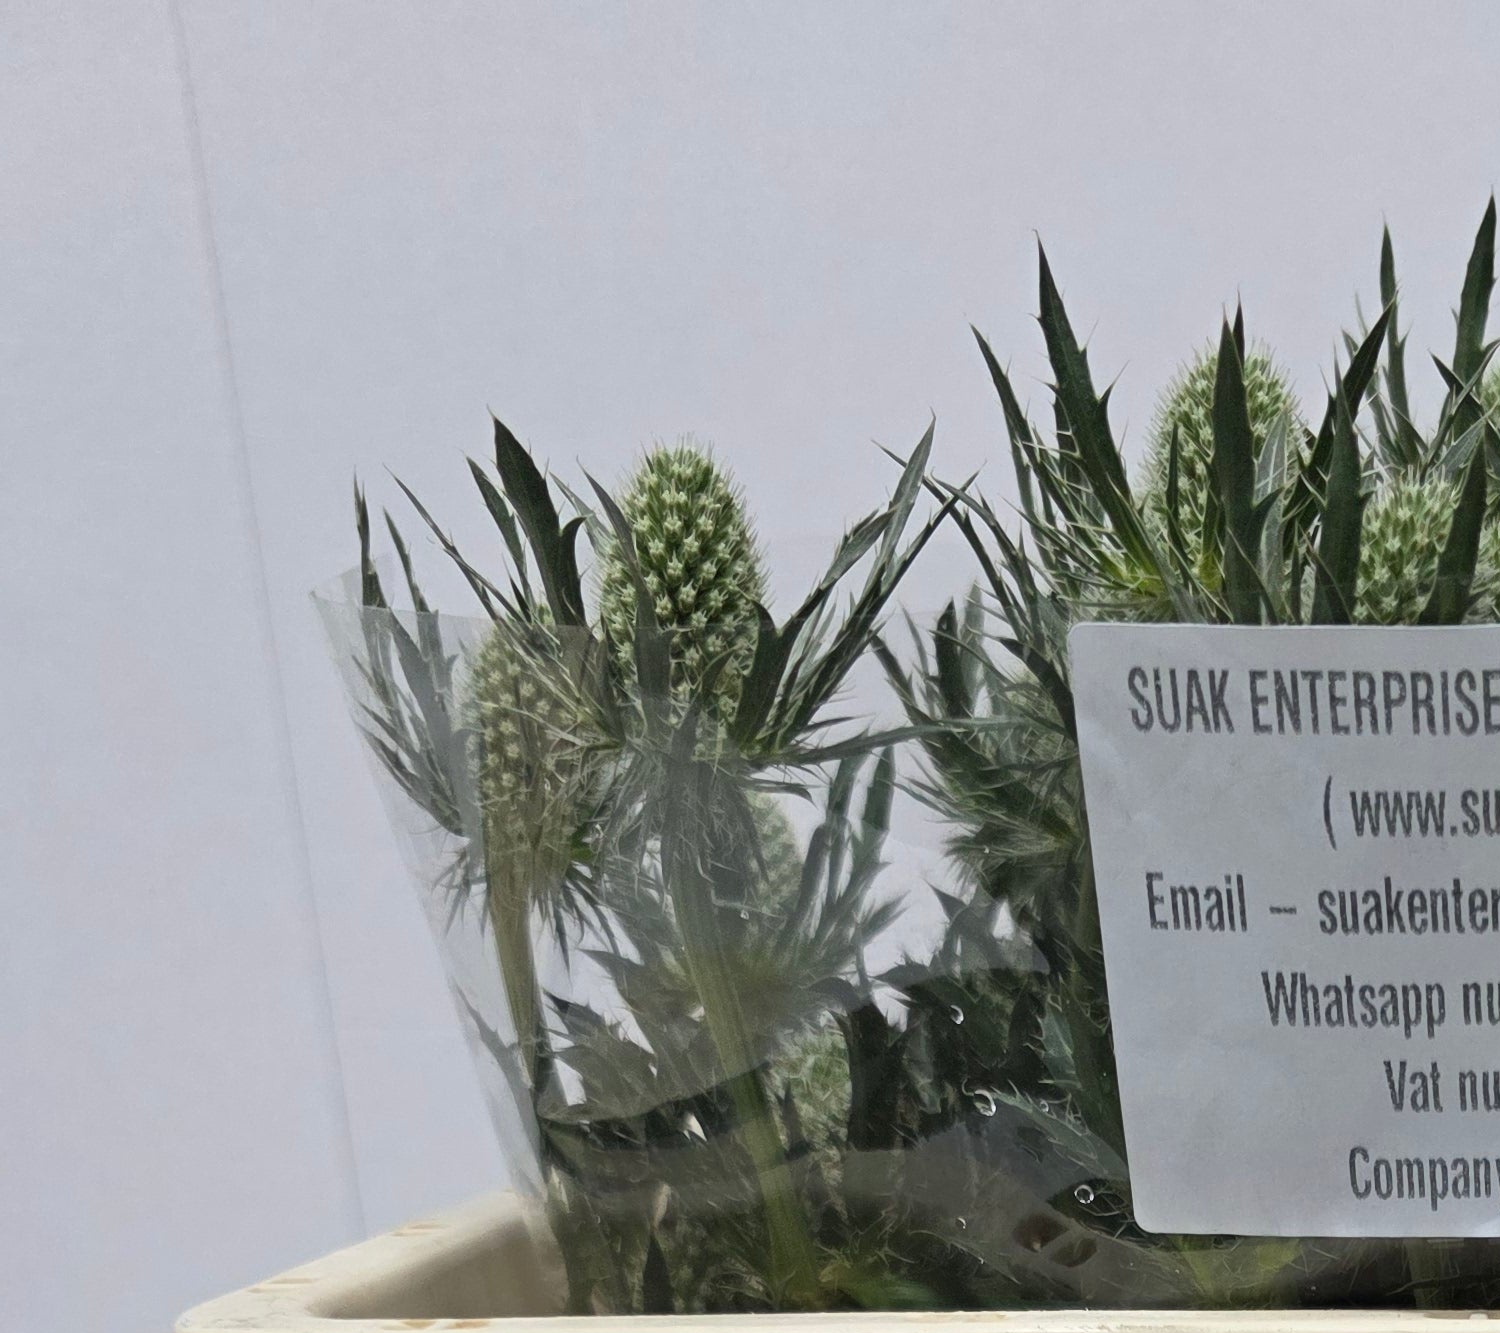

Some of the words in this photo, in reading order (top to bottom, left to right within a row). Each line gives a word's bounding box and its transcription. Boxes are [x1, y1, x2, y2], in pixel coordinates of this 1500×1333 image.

[1127, 665, 1235, 734] SUAK
[1145, 871, 1248, 933] Email
[1260, 970, 1446, 1040] Whatsapp
[1382, 1059, 1444, 1113] Vat
